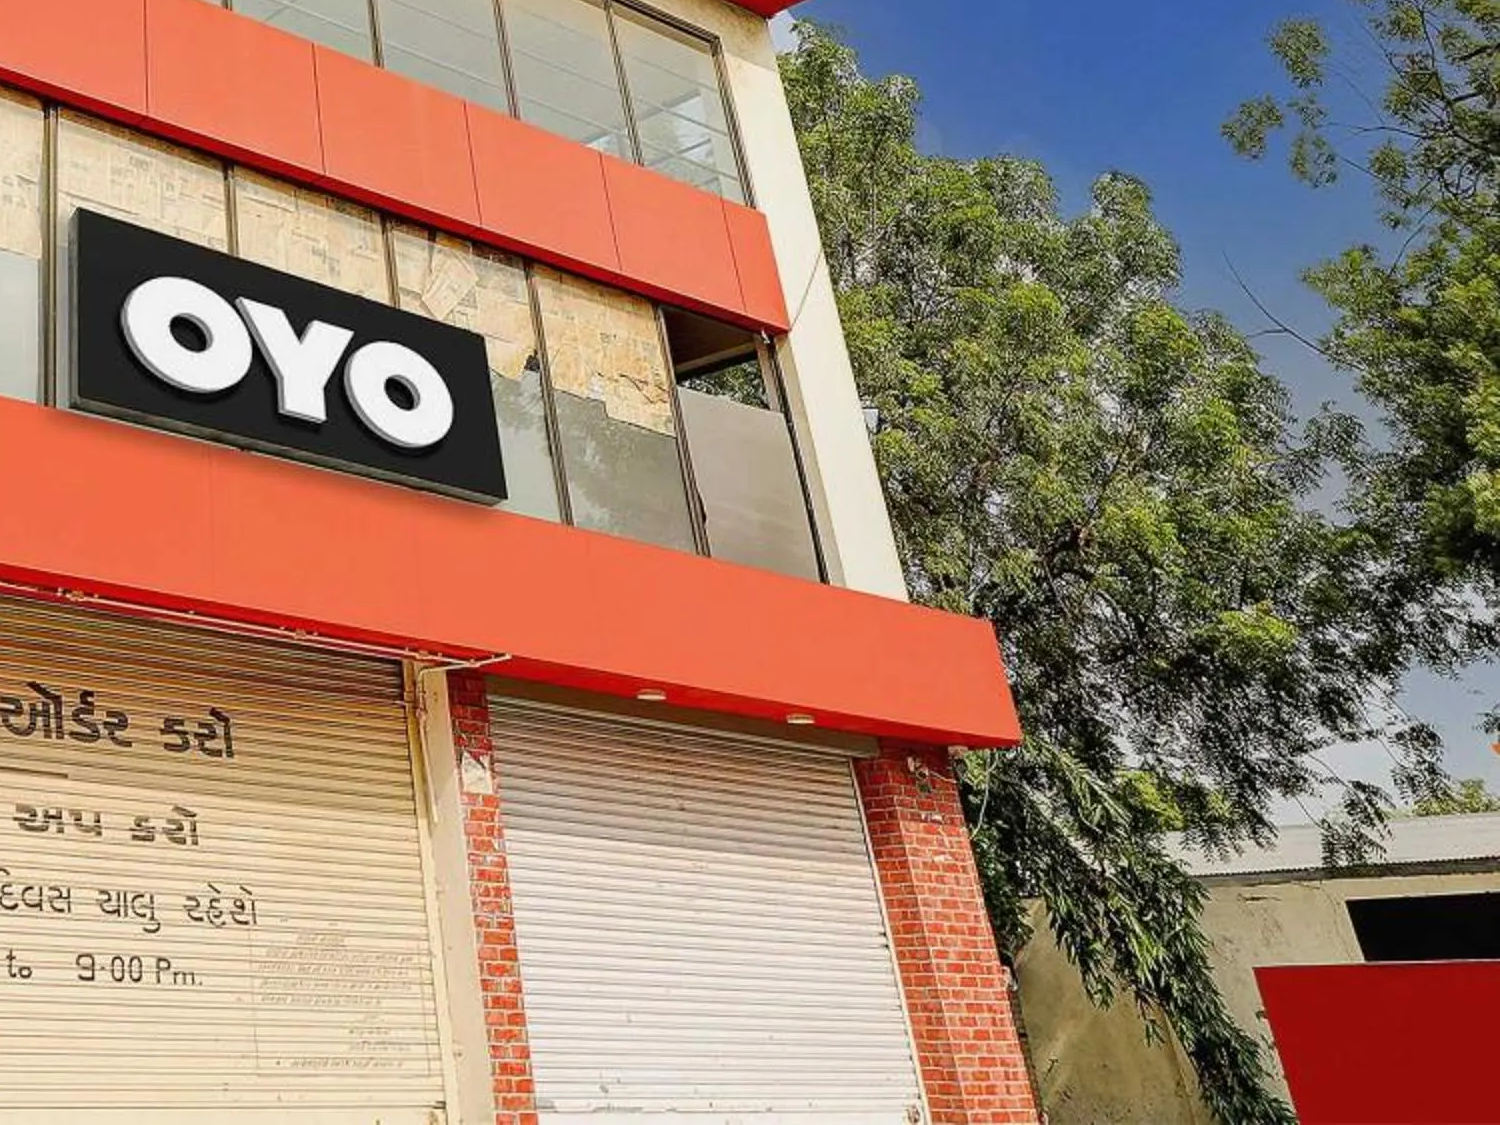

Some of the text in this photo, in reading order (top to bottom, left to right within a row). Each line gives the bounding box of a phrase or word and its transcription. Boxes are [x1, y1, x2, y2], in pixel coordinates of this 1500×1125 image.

[121, 276, 454, 449] OYO
[160, 706, 233, 758] કરો
[13, 803, 102, 837] અપ
[130, 805, 198, 845] કરો
[6, 948, 33, 979] to
